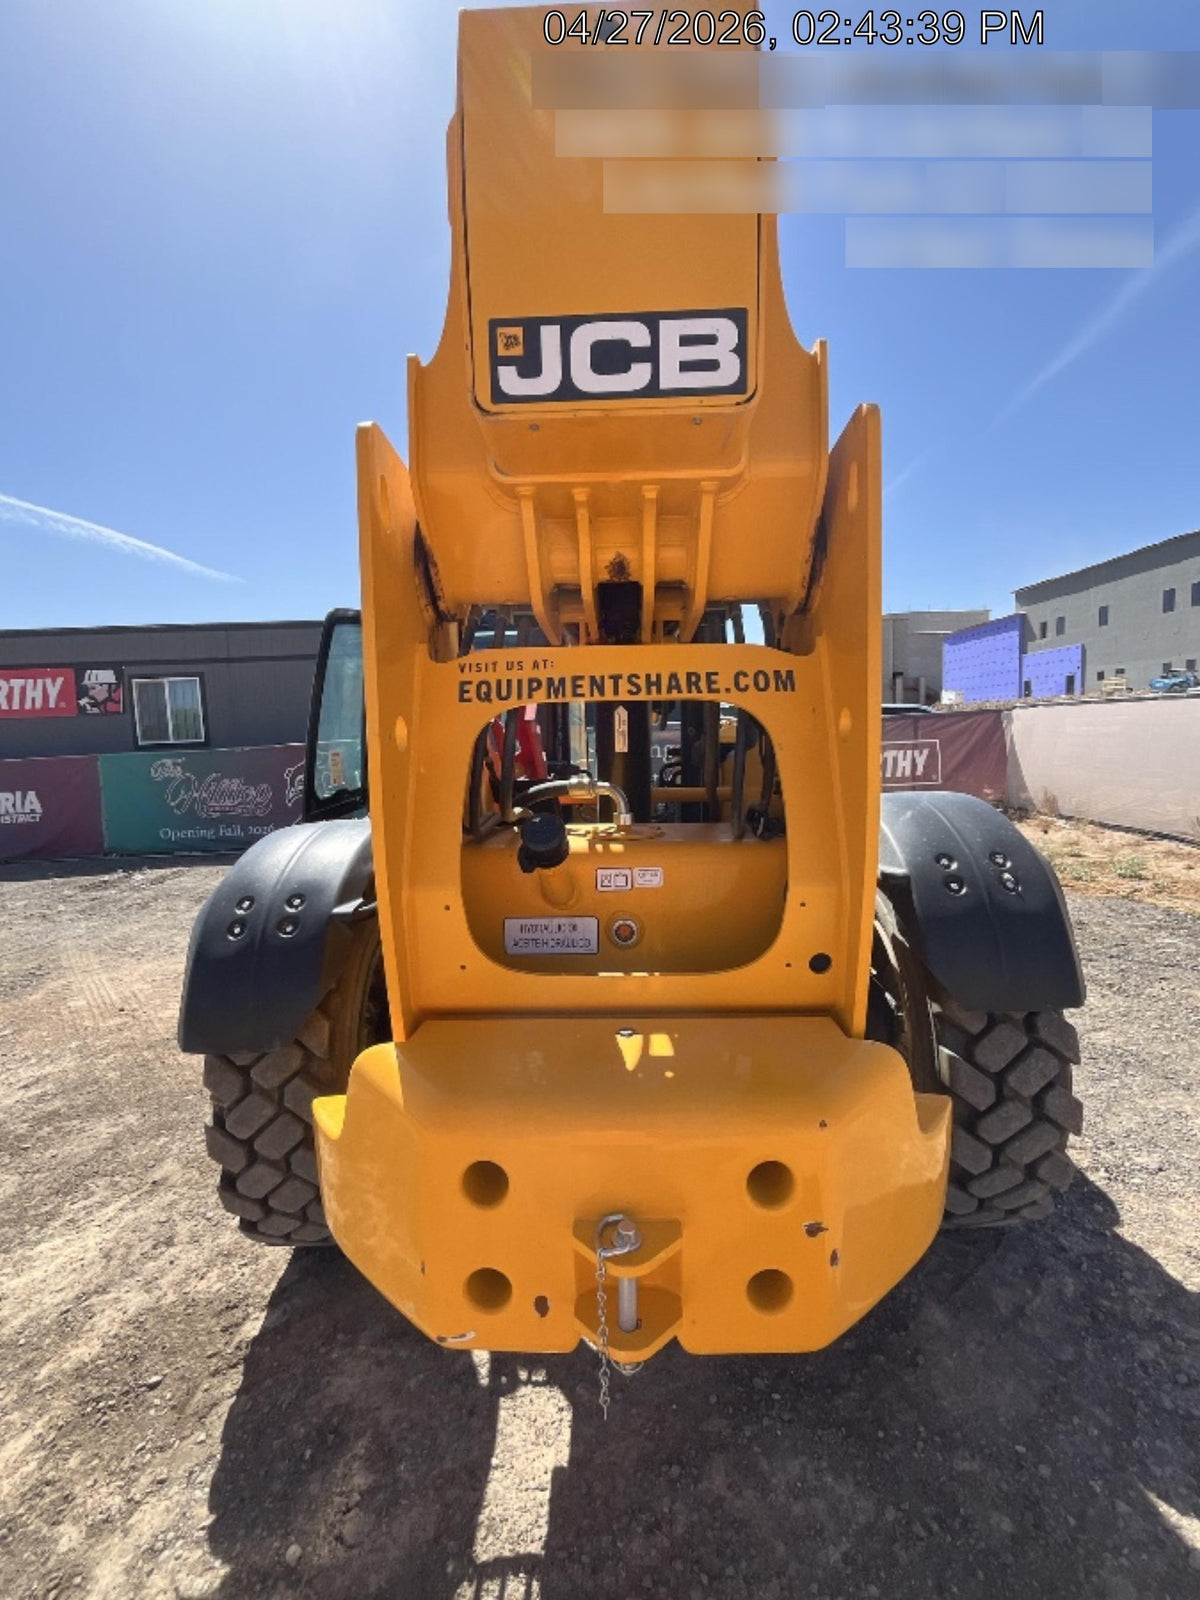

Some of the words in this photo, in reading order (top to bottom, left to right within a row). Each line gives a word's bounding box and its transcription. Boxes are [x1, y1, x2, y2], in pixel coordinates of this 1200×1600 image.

[497, 317, 741, 396] JCB
[458, 661, 499, 673] VISIT
[506, 660, 524, 671] US
[532, 658, 555, 671] AT:
[458, 669, 796, 703] EQUIPMENTSHARE.COM
[159, 826, 217, 841] Opening
